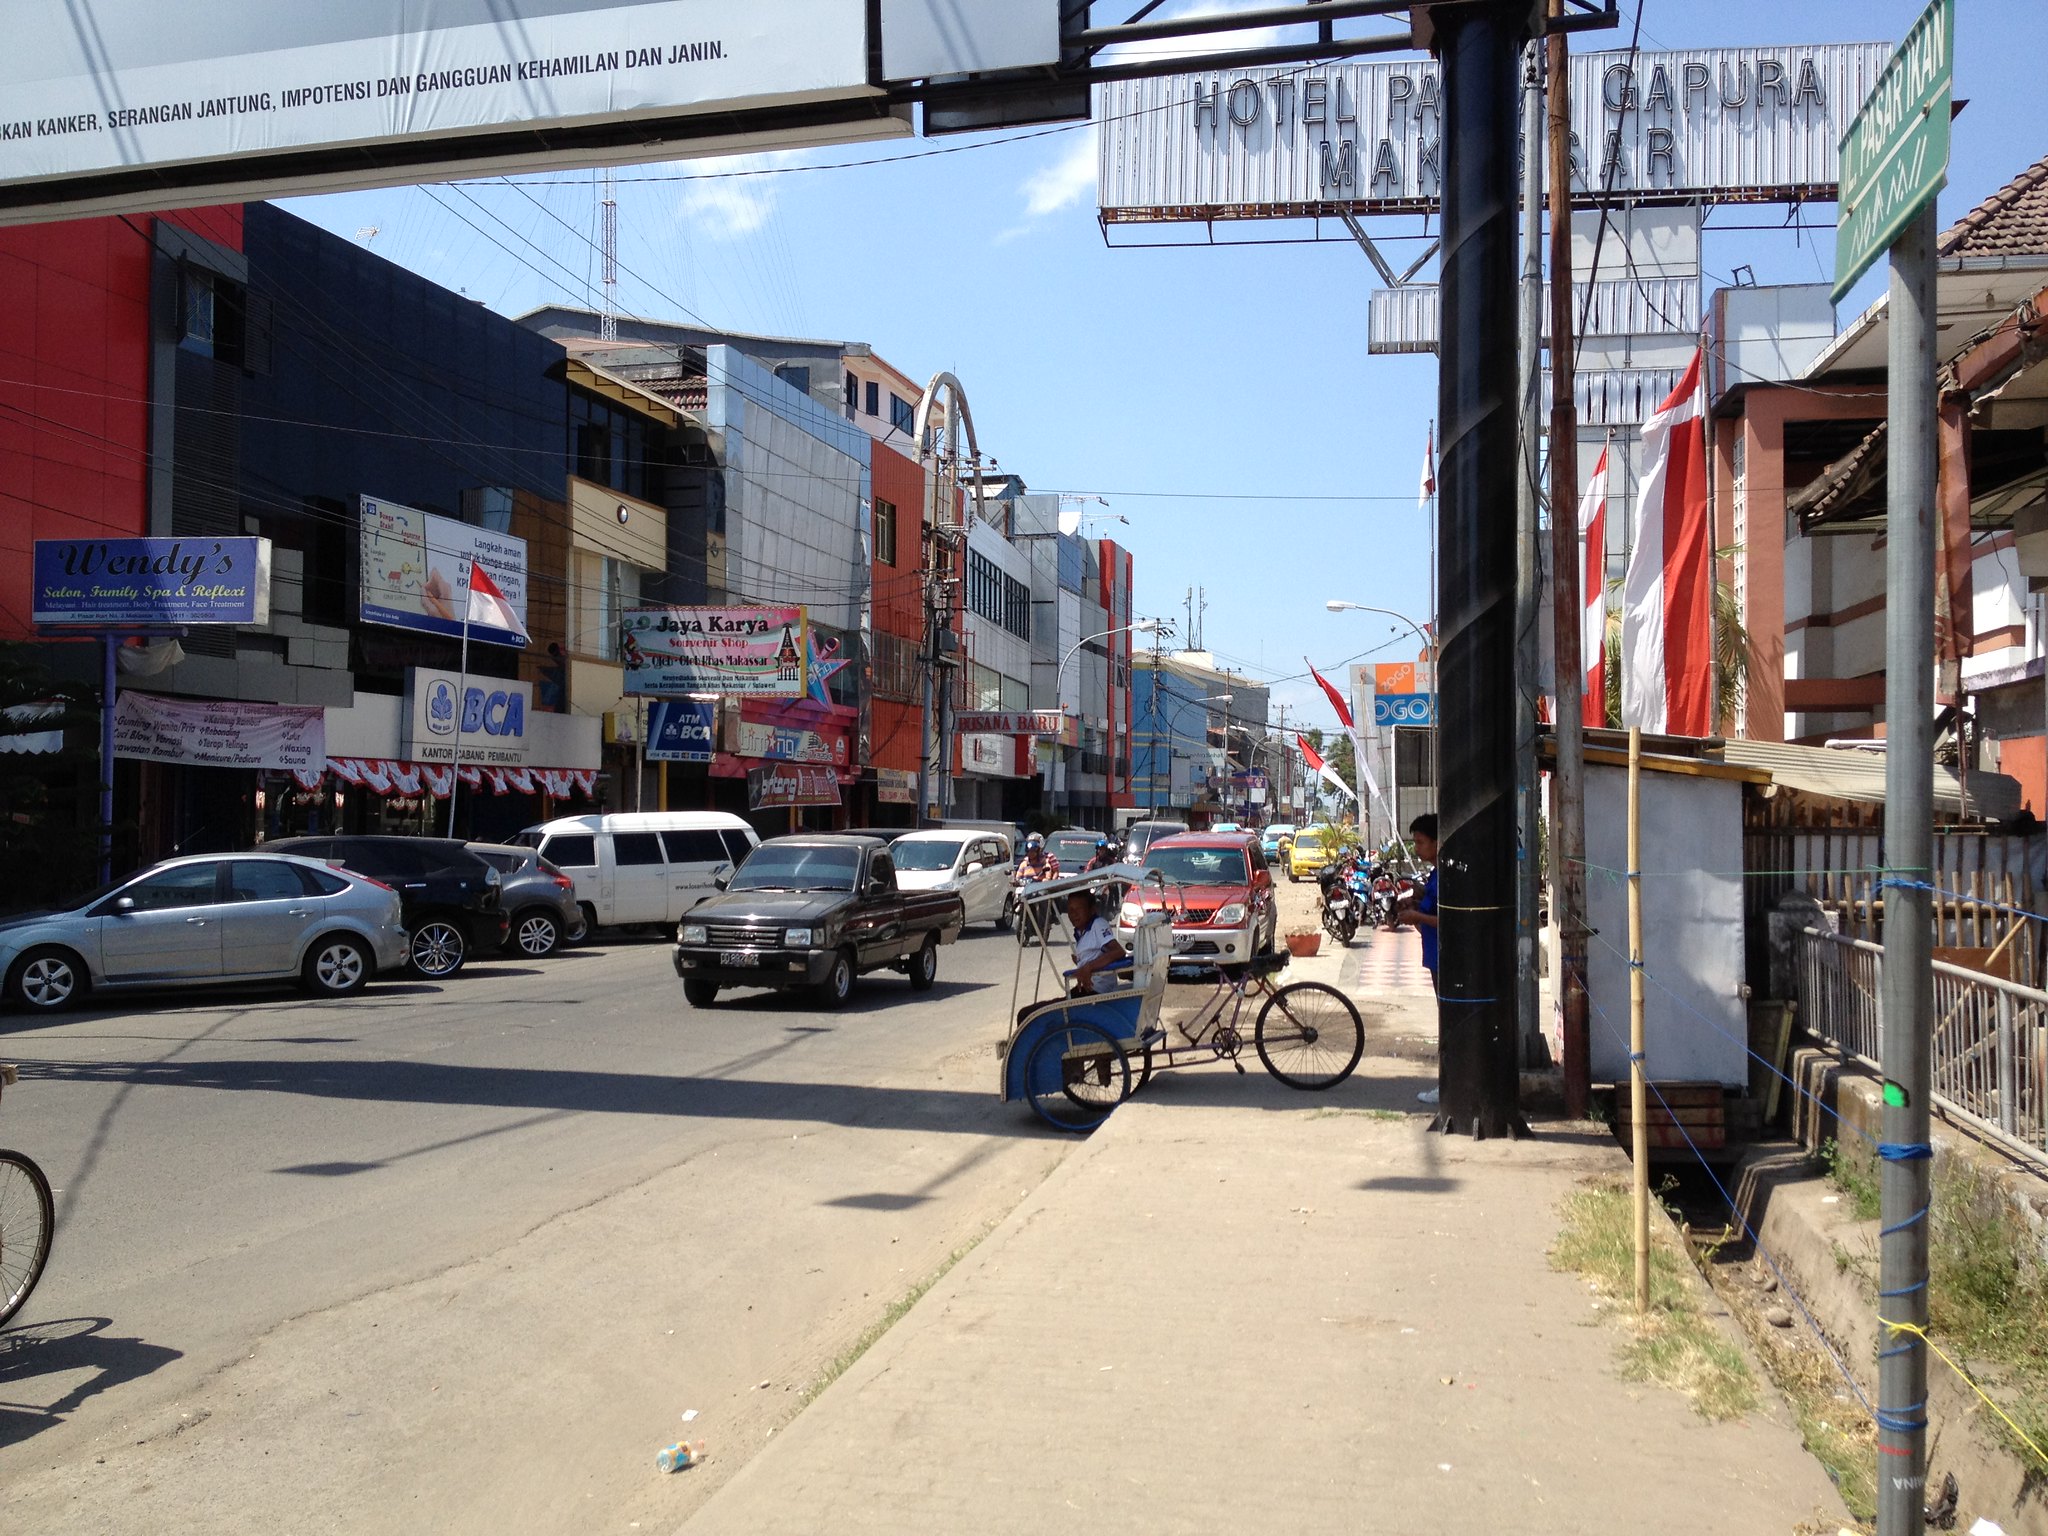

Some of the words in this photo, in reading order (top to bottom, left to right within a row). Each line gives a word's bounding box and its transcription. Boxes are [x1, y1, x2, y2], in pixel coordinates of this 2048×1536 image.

[0, 121, 31, 140] KAN
[37, 113, 103, 136] KANKER,
[108, 102, 192, 128] SERANGAN
[196, 92, 277, 118] JANTUNG,
[281, 80, 371, 108] IMPOTENSI
[377, 75, 411, 97] DAN
[416, 64, 511, 92] GANGGUAN
[517, 51, 619, 80] KEHAMILAN
[625, 46, 662, 68] DAN
[668, 40, 728, 64] JANIN.
[1193, 76, 1356, 128] HOTEL
[1602, 57, 1824, 112] GAPURA
[1859, 58, 1904, 177] PASAR
[1905, 2, 1946, 113] IKAN
[1319, 127, 1676, 188] MAKAR
[474, 538, 503, 553] Langkah
[503, 546, 522, 558] aman
[58, 543, 234, 586] Wendy's
[458, 562, 465, 572] &
[498, 574, 521, 587] ringan,
[43, 586, 87, 600] Salon,
[89, 585, 139, 601] Family
[142, 585, 172, 600] Spa
[175, 586, 187, 597] &
[190, 585, 246, 600] Reflexi
[82, 601, 97, 609] Hair
[133, 600, 152, 609] Body
[191, 600, 208, 608] Face
[209, 600, 246, 608] Treatment
[656, 616, 703, 636] Jaya
[708, 616, 769, 636] Karya
[669, 638, 718, 649] Souvenir
[721, 638, 749, 650] Shop
[725, 655, 769, 667] Makassar
[461, 687, 524, 737] BCA
[1375, 698, 1429, 721] OGO
[118, 715, 151, 730] Gunting
[678, 713, 700, 724] ATM
[958, 715, 1012, 732] BUSANA
[1017, 714, 1059, 731] BARU
[204, 726, 241, 739] Rebonding
[680, 726, 711, 740] BCA
[152, 746, 184, 758] Rambut
[284, 744, 312, 756] Waxing
[422, 747, 453, 759] KANTOR
[487, 751, 522, 763] PEMBANTU
[284, 755, 306, 765] Sauna
